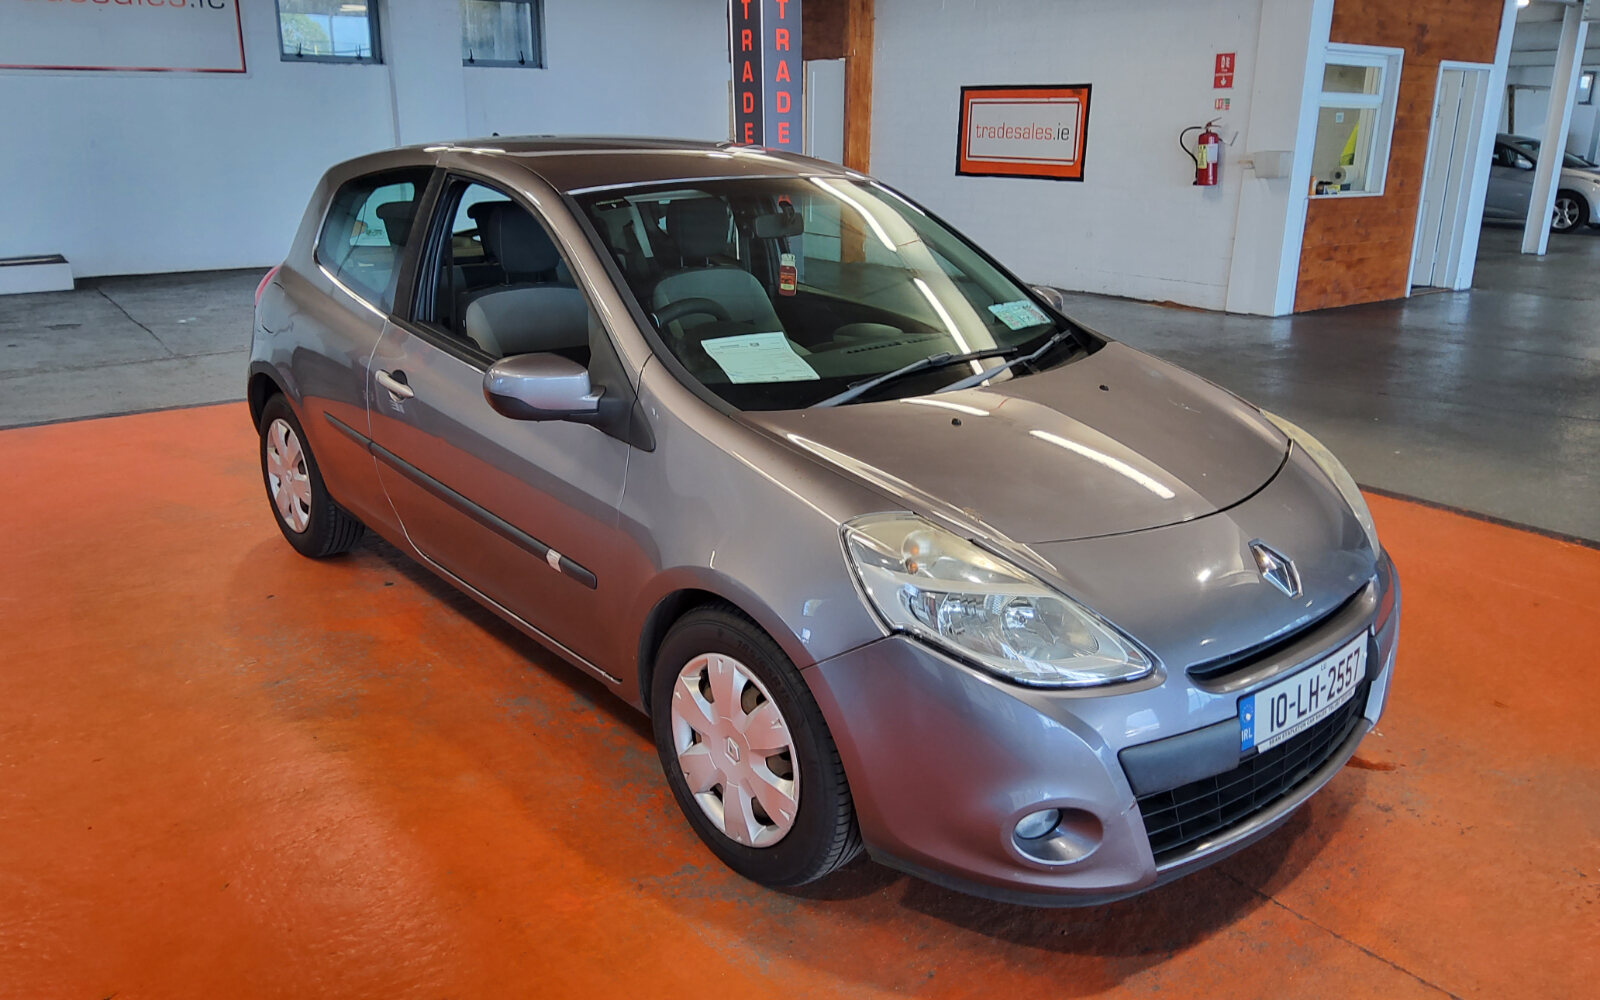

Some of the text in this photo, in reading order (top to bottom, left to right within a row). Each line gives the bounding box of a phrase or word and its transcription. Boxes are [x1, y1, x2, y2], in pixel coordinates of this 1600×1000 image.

[741, 0, 754, 144] TRADE
[775, 0, 791, 144] TRADE
[976, 122, 1070, 141] tradesales.ie
[1270, 647, 1360, 732] 10-LH-2557
[1241, 728, 1252, 742] IRL
